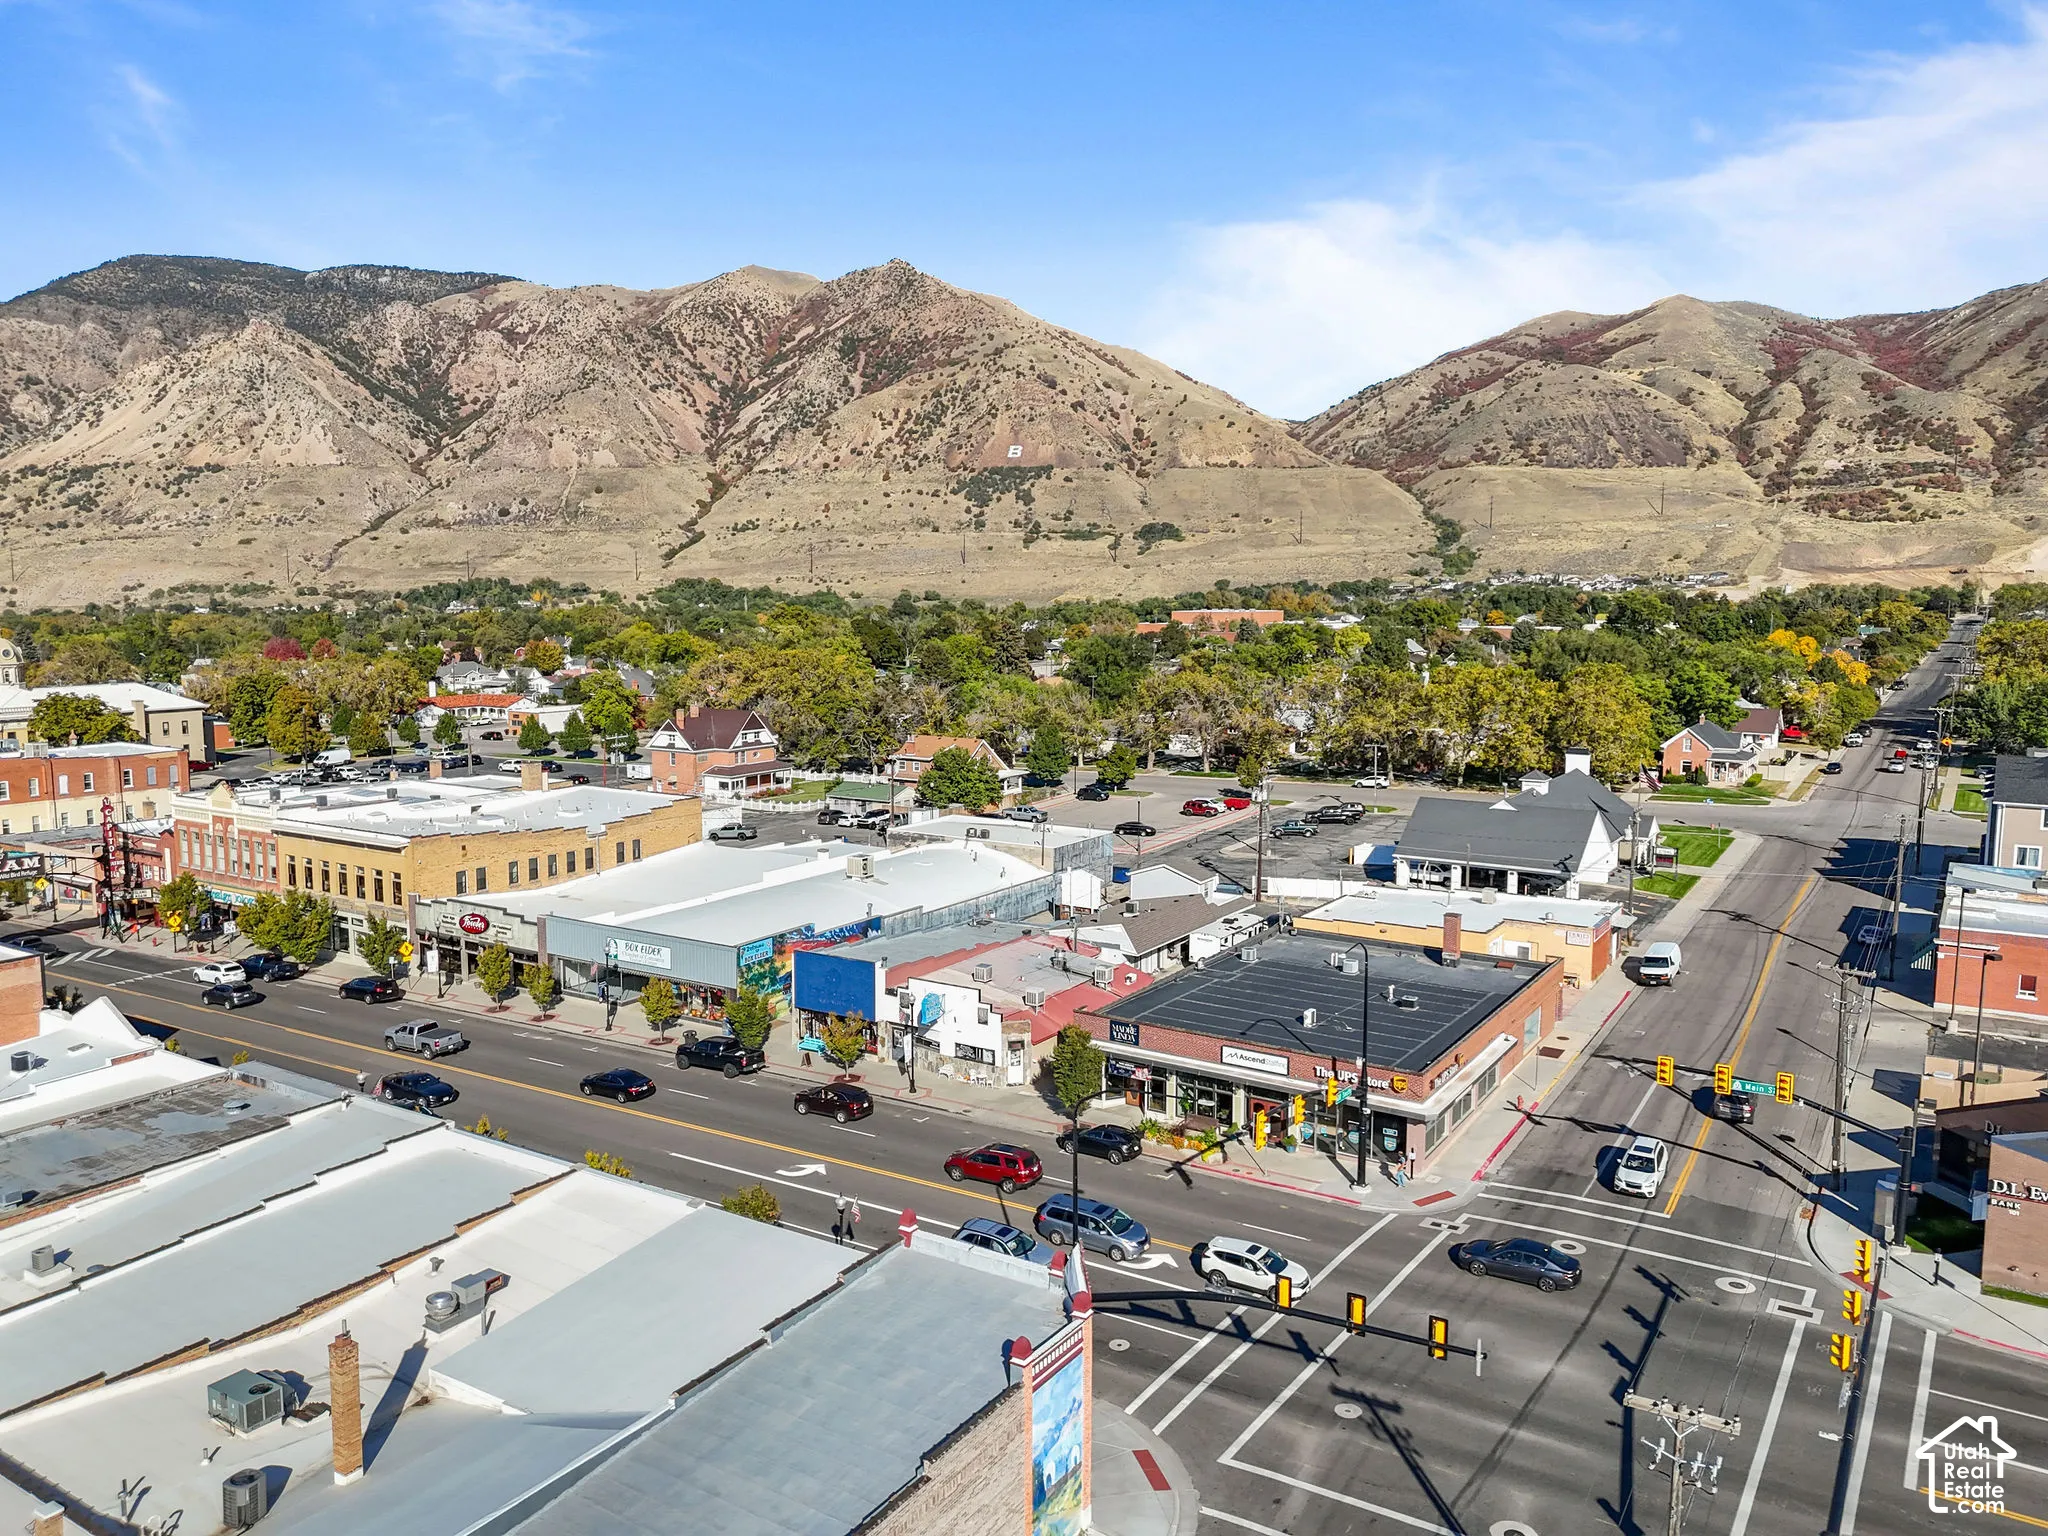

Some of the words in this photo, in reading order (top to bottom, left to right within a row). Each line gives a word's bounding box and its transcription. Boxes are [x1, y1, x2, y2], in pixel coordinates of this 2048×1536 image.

[1007, 445, 1023, 458] B
[105, 809, 115, 859] CAPITOL
[0, 857, 41, 872] AM
[625, 942, 639, 952] BOX
[641, 945, 662, 957] ELDER
[1239, 1054, 1265, 1064] Ascend
[1315, 1066, 1335, 1078] The
[1338, 1070, 1358, 1083] UPS
[1367, 1076, 1389, 1089] tore
[1745, 1084, 1764, 1092] Main
[1992, 1179, 2026, 1198] D.L.
[1991, 1198, 2021, 1209] BANK
